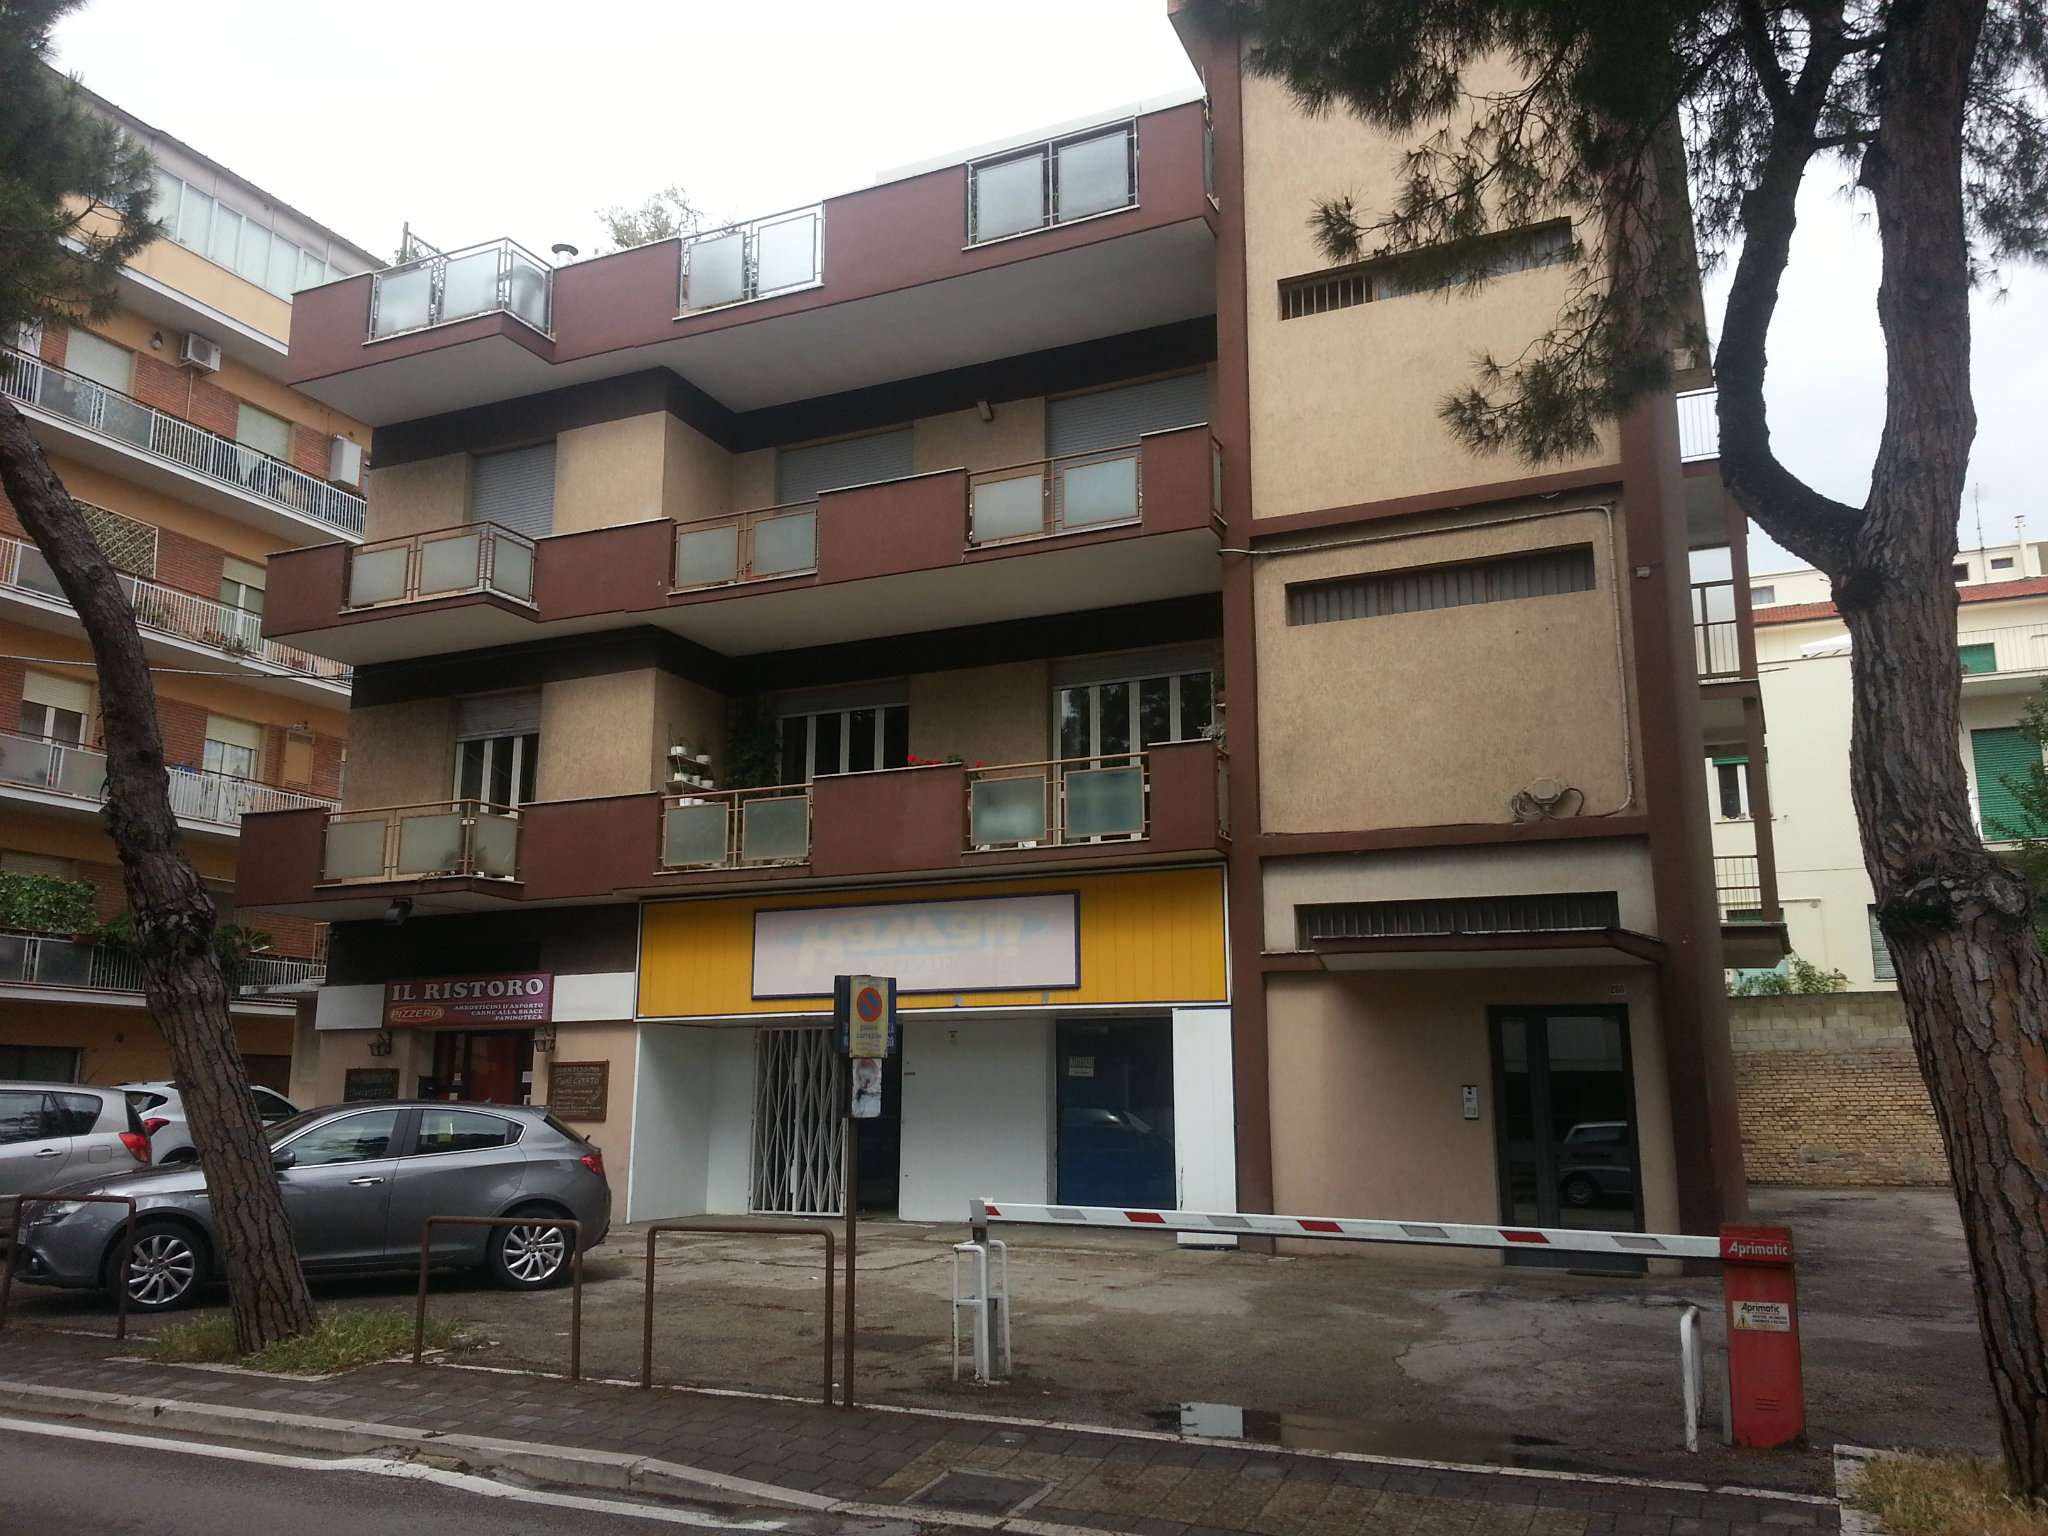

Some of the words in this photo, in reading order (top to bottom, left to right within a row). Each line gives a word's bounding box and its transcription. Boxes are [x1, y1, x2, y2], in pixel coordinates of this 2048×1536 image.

[392, 984, 416, 1001] IL
[424, 978, 544, 1000] RISTORO
[391, 1006, 443, 1018] PIZZERIA
[1728, 1240, 1788, 1257] Aprimatic
[1741, 1302, 1780, 1313] Aprimatic
